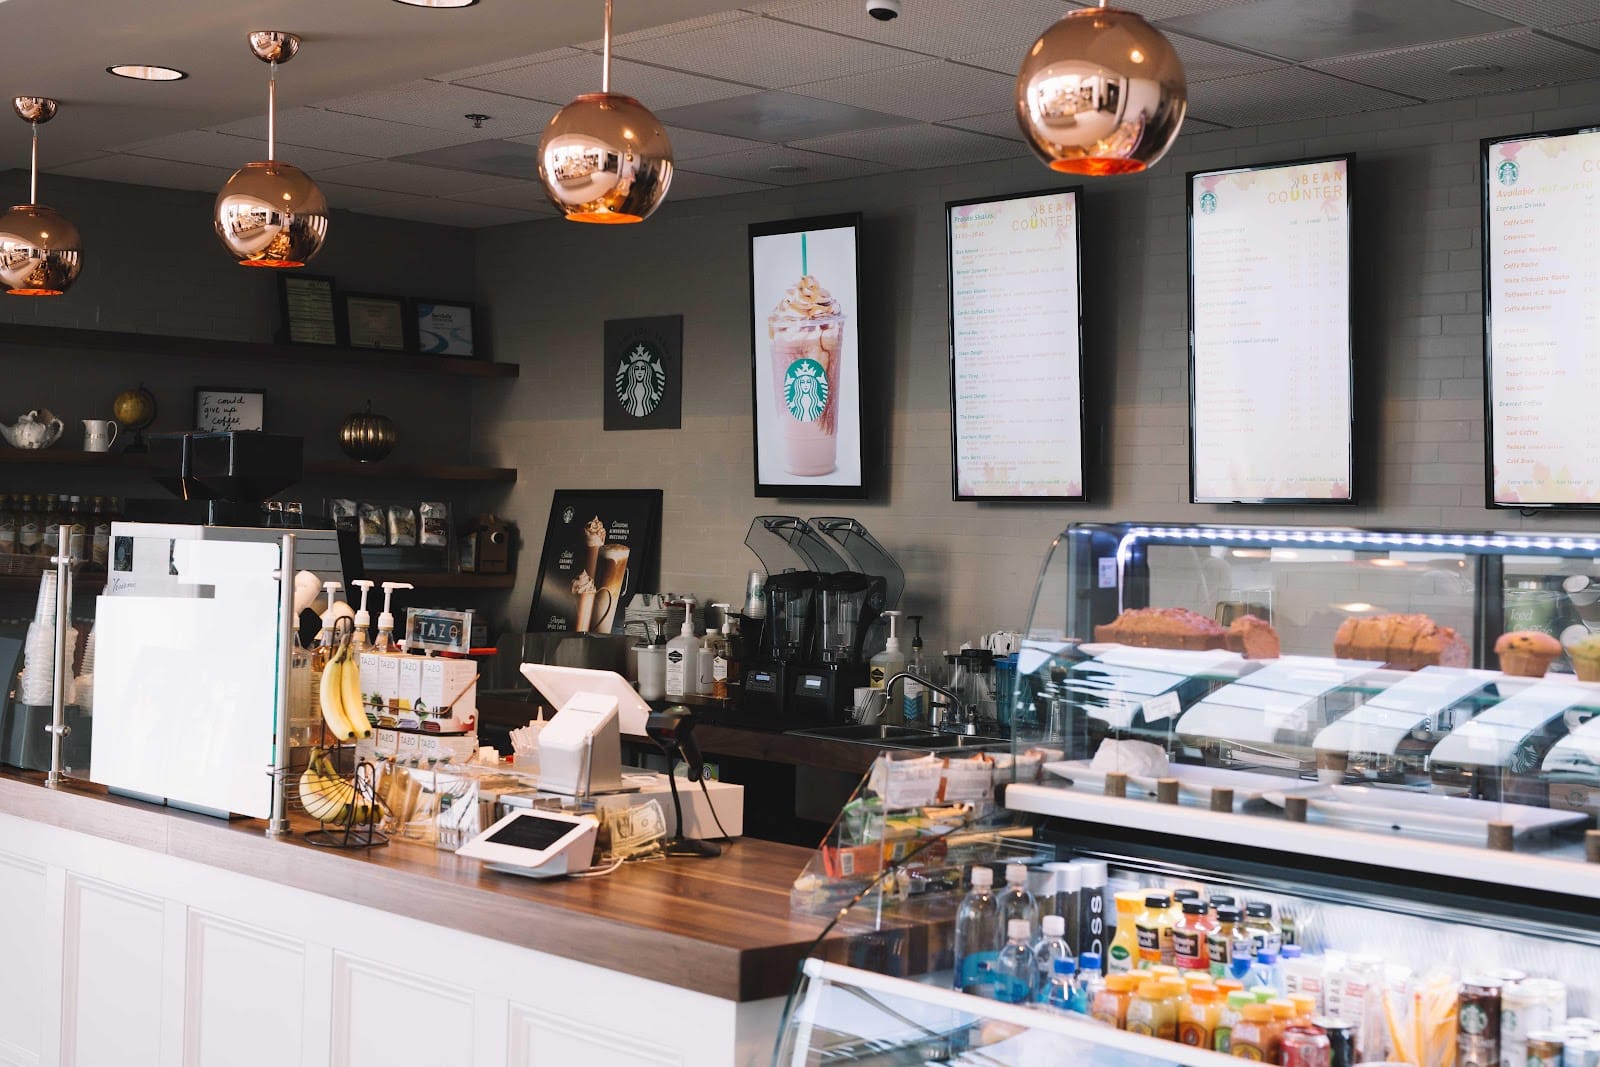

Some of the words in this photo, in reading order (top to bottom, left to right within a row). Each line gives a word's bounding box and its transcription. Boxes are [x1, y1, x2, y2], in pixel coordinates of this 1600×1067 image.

[1302, 171, 1343, 185] BEAN
[1267, 185, 1343, 204] COUNTER
[1497, 186, 1534, 197] Available
[1040, 202, 1073, 214] BEAN
[1524, 201, 1546, 209] Drinks
[1011, 214, 1073, 232] COUNTER
[217, 395, 246, 404] could
[204, 407, 220, 418] give
[223, 407, 238, 416] up
[418, 621, 458, 640] TAZO
[361, 656, 376, 667] TAZO
[380, 660, 396, 669] TAZO
[402, 662, 417, 672] TAZO
[425, 664, 441, 673] TAZO
[379, 733, 394, 743] TAZO
[400, 736, 416, 746] TAZO
[1091, 895, 1103, 954] OSS
